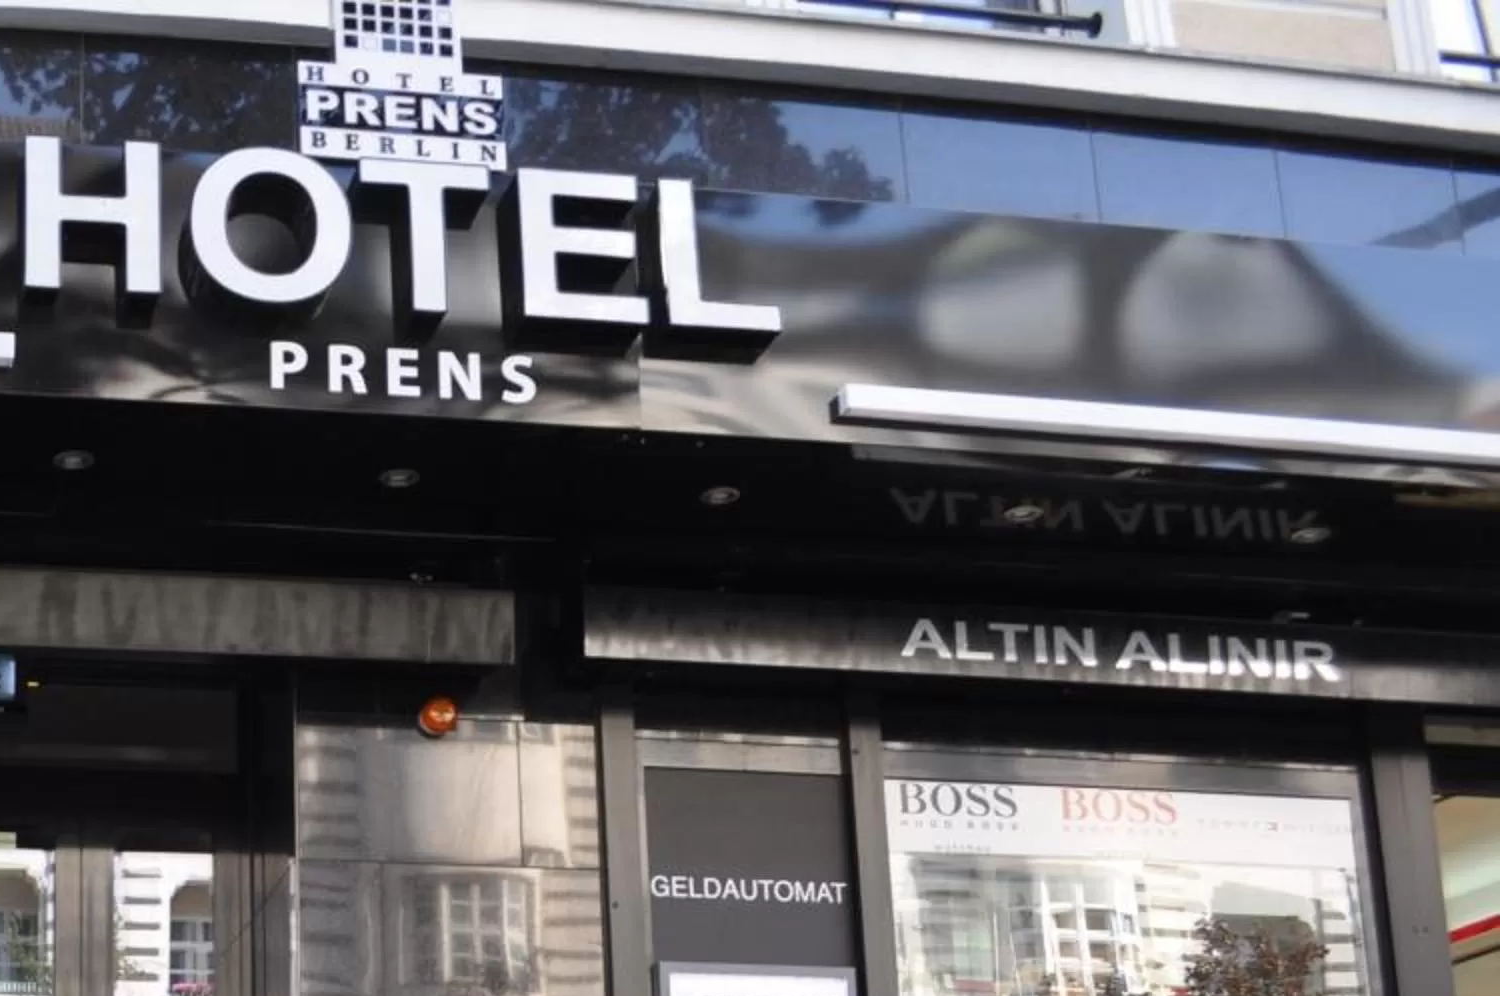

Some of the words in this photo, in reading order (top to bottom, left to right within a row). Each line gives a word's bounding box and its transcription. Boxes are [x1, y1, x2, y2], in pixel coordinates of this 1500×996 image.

[305, 65, 495, 97] HOTEL
[305, 88, 498, 135] PRENS
[310, 130, 498, 162] BERLIN
[24, 135, 782, 332] HOTEL
[269, 340, 537, 404] PRENS
[900, 618, 1098, 668] ALTIN
[1114, 629, 1343, 682] ALINIR
[899, 782, 1018, 819] BOSS
[1060, 788, 1178, 827] BOSS
[650, 875, 848, 904] GELDAUTOMAT
